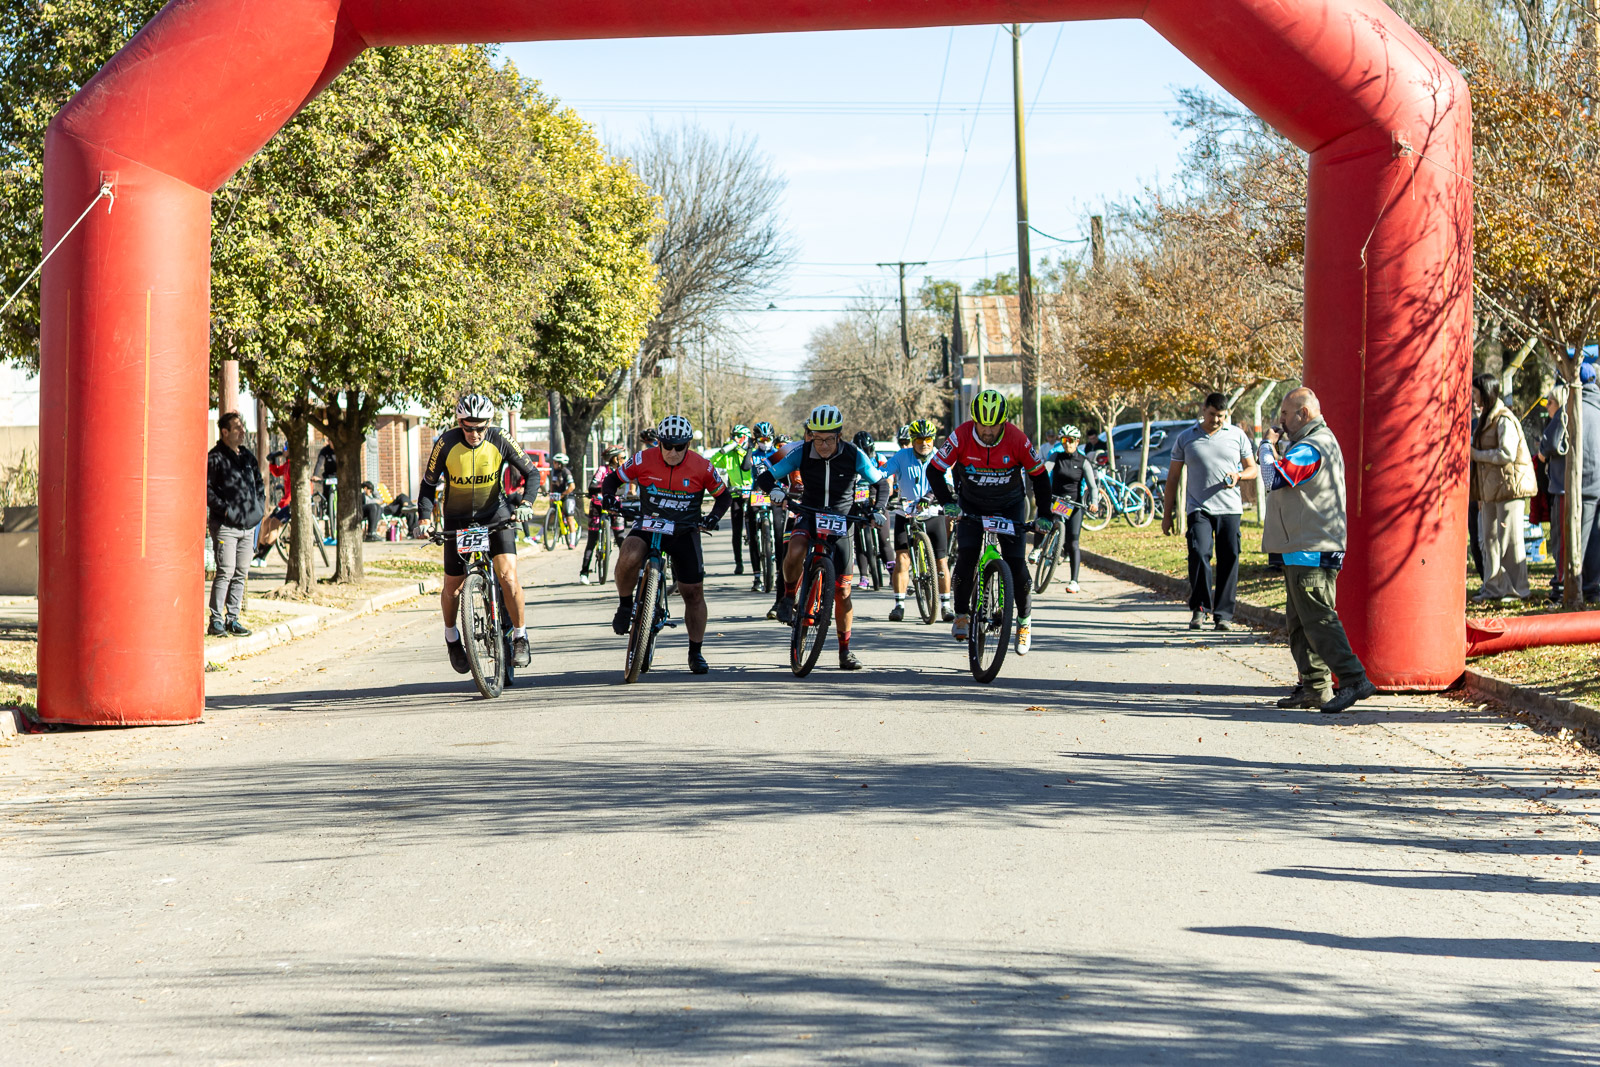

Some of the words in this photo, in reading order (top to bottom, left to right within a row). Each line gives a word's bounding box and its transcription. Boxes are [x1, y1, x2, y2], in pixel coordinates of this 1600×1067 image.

[499, 428, 525, 458] MAXIBIKE
[428, 437, 445, 473] MAXIBIKE
[450, 471, 499, 485] MAXIBIKE
[756, 495, 765, 503] 15
[649, 520, 666, 529] 13
[818, 518, 843, 531] 213
[988, 520, 1008, 530] 30
[462, 533, 483, 547] 65
